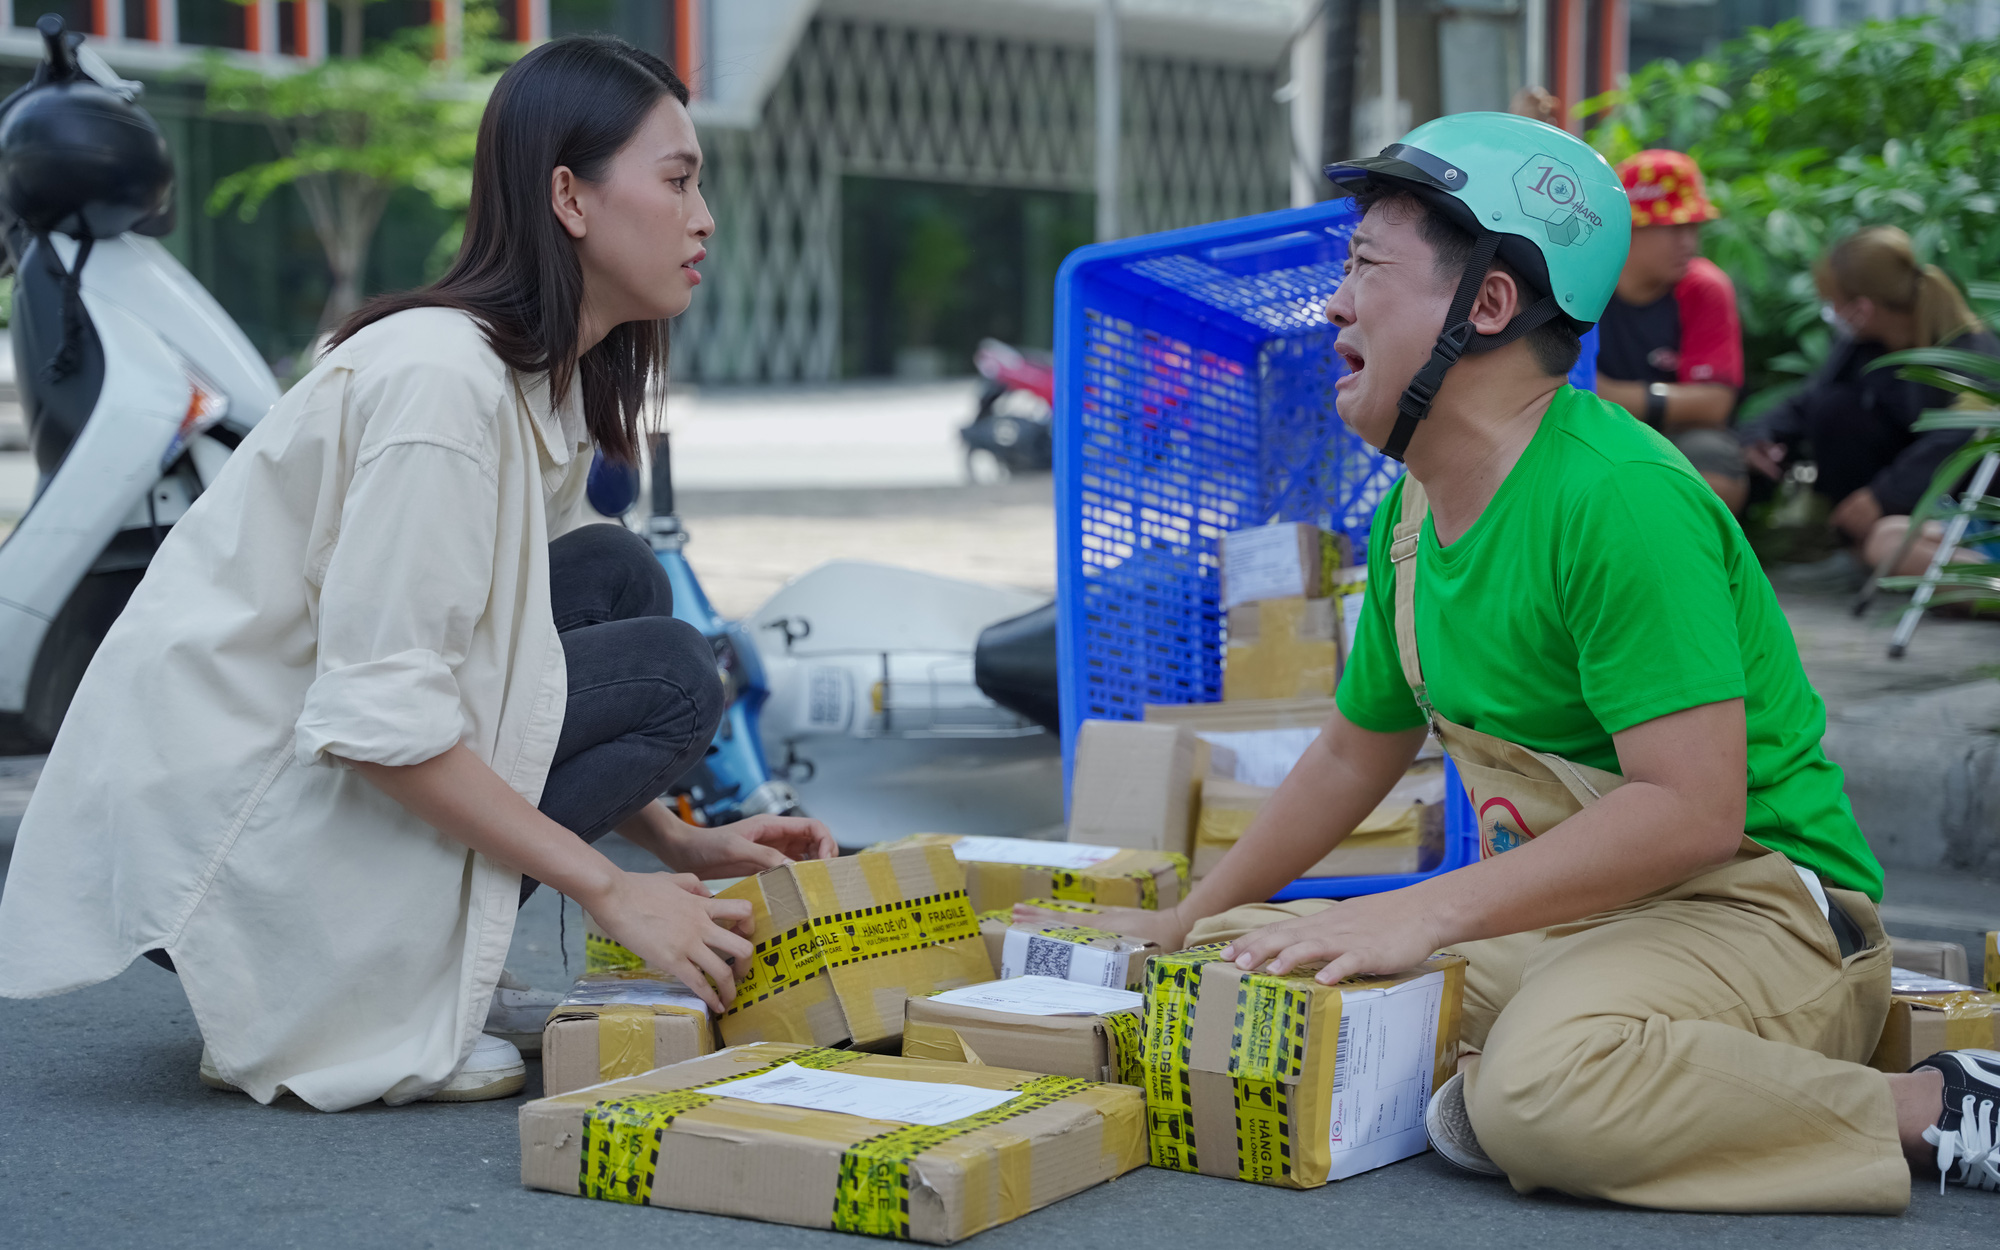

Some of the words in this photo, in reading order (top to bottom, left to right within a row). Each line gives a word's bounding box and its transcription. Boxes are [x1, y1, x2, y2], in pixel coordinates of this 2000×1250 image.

[1527, 166, 1576, 204] 10
[927, 906, 966, 923] FRAGILE
[862, 923, 884, 937] HÀNG
[790, 932, 839, 960] FRAGILE
[795, 956, 815, 969] HAND
[815, 949, 829, 960] WITH
[829, 945, 843, 954] CARE
[744, 982, 757, 992] TAY
[1162, 1002, 1178, 1046] HÀNG
[1257, 986, 1276, 1067] FRAGILE
[1248, 1038, 1256, 1066] CARE
[620, 1132, 629, 1152] TAY
[1250, 1137, 1258, 1164] LÒNG
[1259, 1119, 1273, 1161] HÀNG
[878, 1162, 889, 1209] GILE
